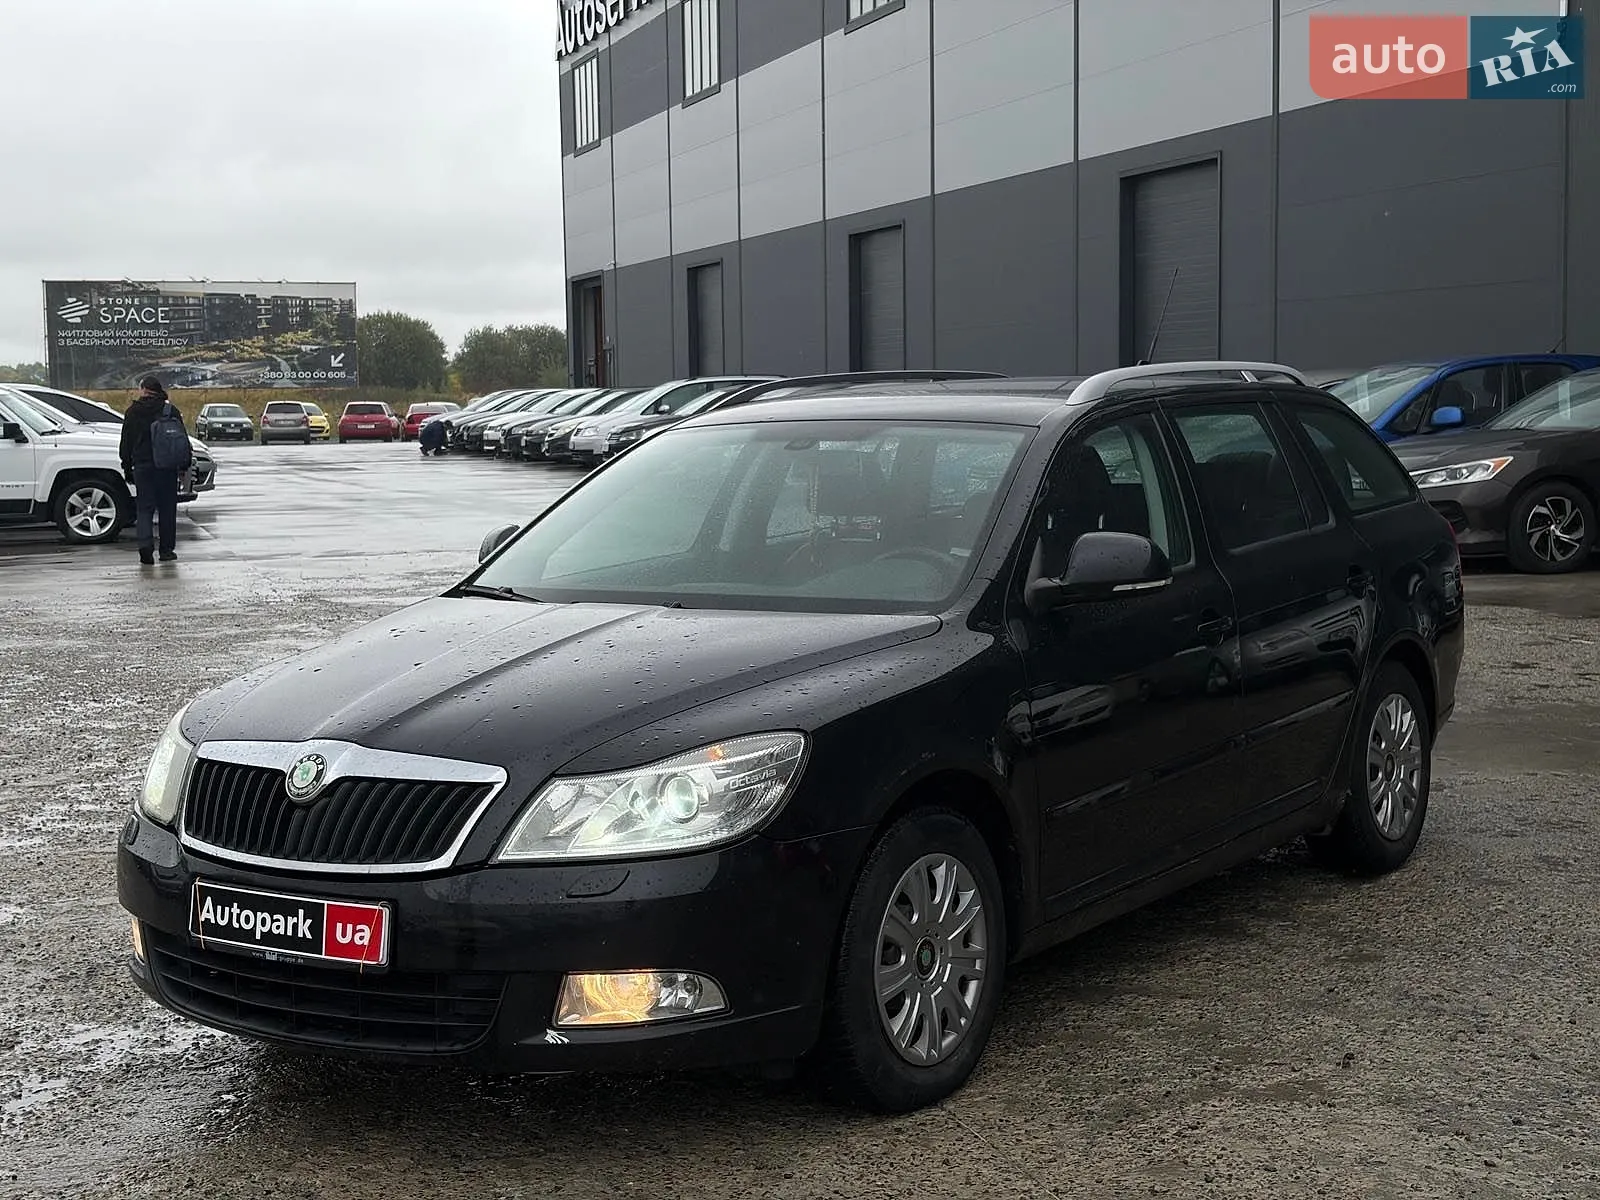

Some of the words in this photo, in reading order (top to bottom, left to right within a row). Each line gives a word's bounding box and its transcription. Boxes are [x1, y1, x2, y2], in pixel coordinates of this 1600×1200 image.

[556, 0, 648, 56] Autose
[99, 297, 140, 305] STONE
[99, 307, 170, 323] SPACE
[57, 328, 115, 337] ЖИТЛОВИЙ
[115, 329, 169, 337] КОМПЛЕКС
[66, 337, 120, 346] БАСЕЙНОМ
[121, 338, 167, 346] ПОСЕРЕД
[167, 338, 189, 346] ЛІСУ
[200, 895, 313, 940] Autopark
[335, 922, 371, 946] ua
